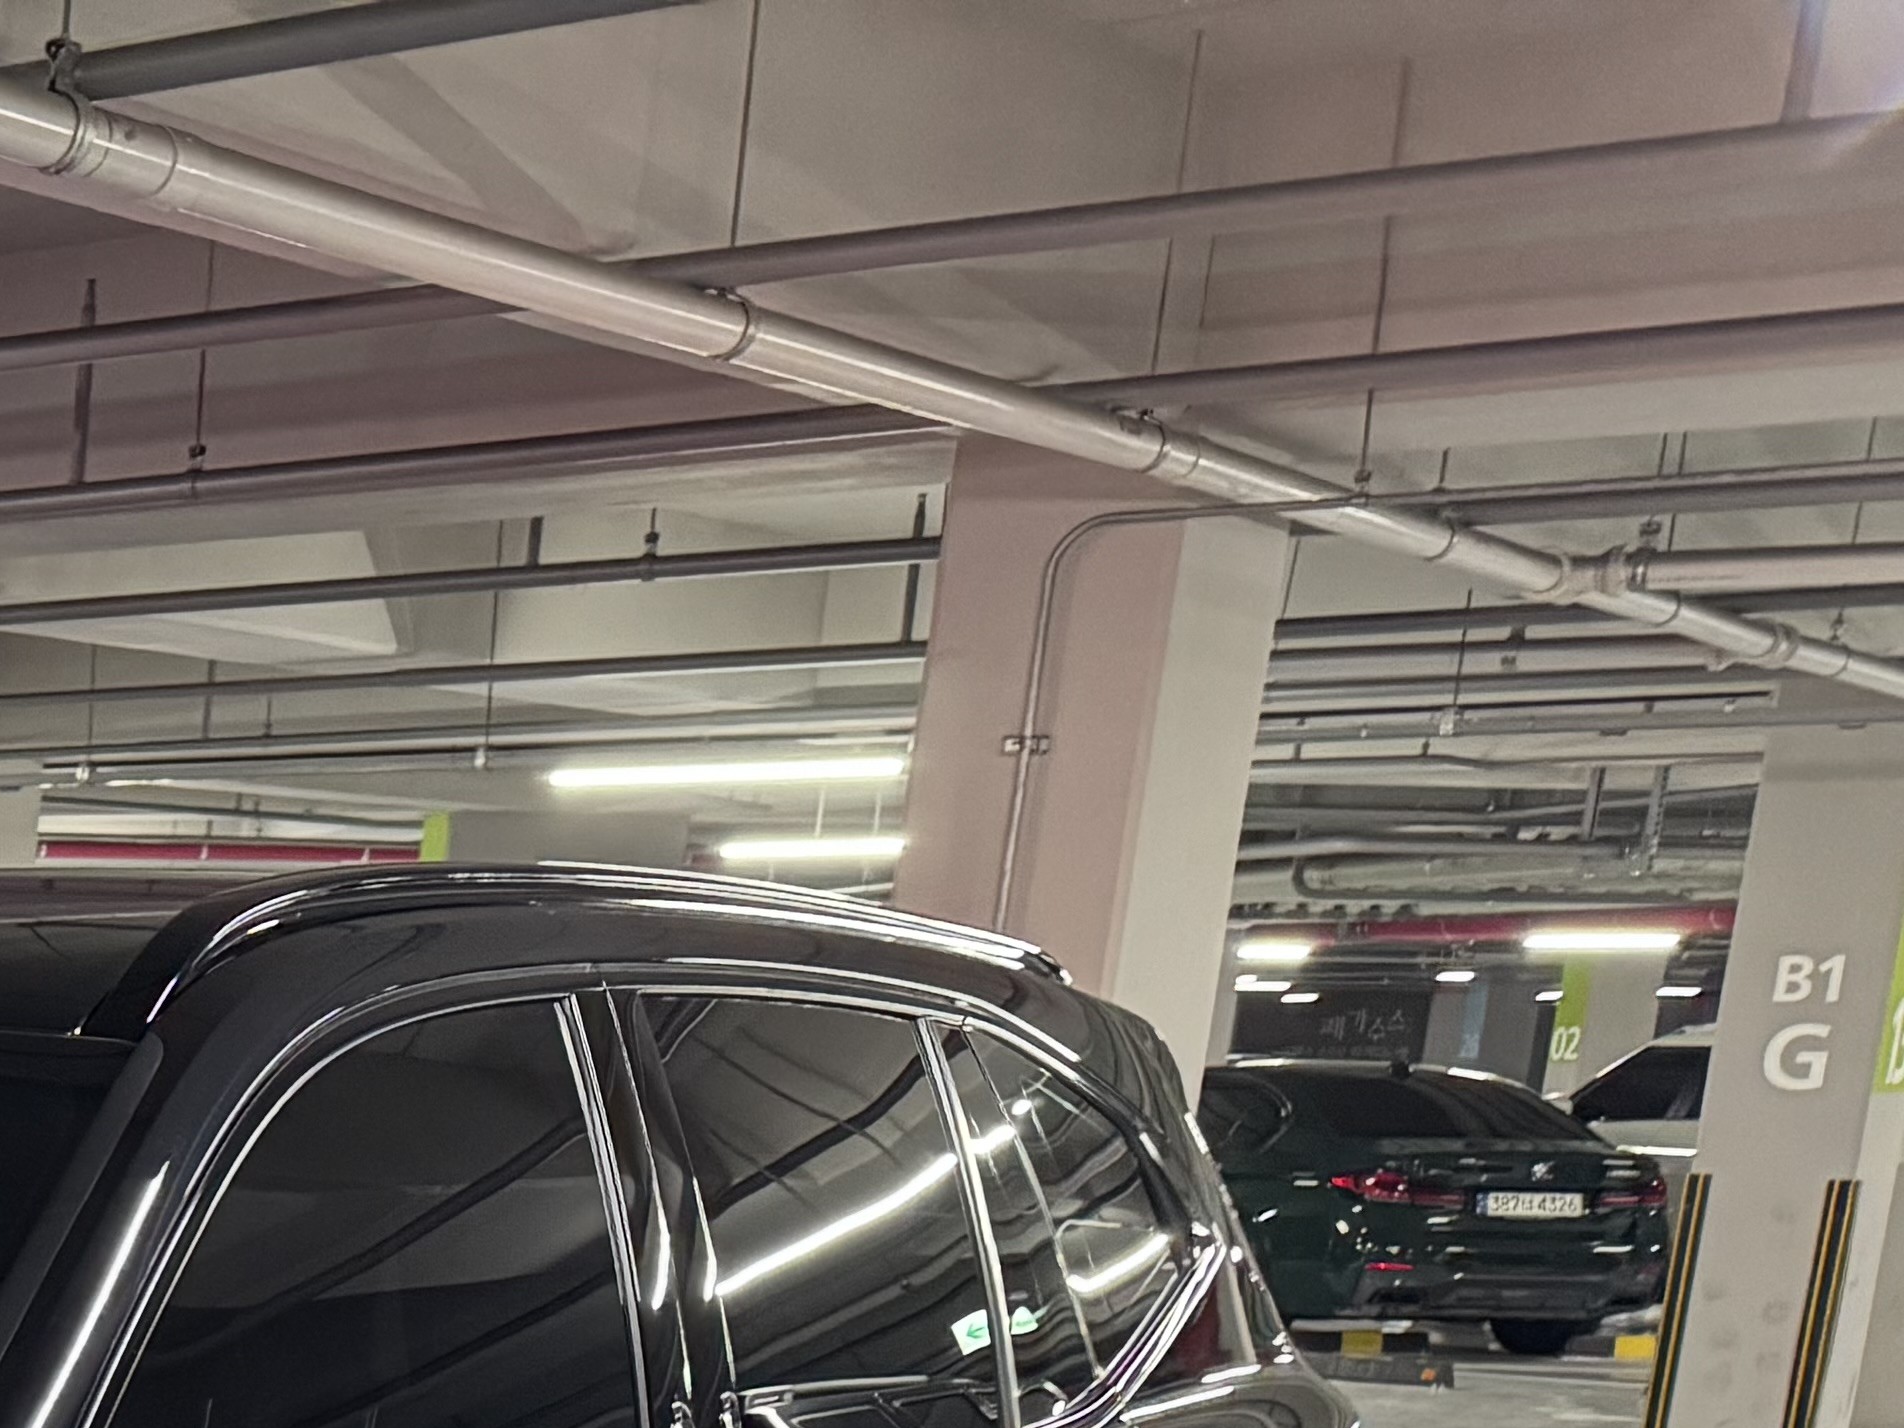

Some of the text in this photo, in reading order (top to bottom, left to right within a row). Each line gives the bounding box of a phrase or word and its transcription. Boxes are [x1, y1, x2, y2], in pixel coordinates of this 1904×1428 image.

[1771, 954, 1847, 1004] B1
[1550, 1026, 1581, 1061] 02
[1763, 1022, 1832, 1091] G
